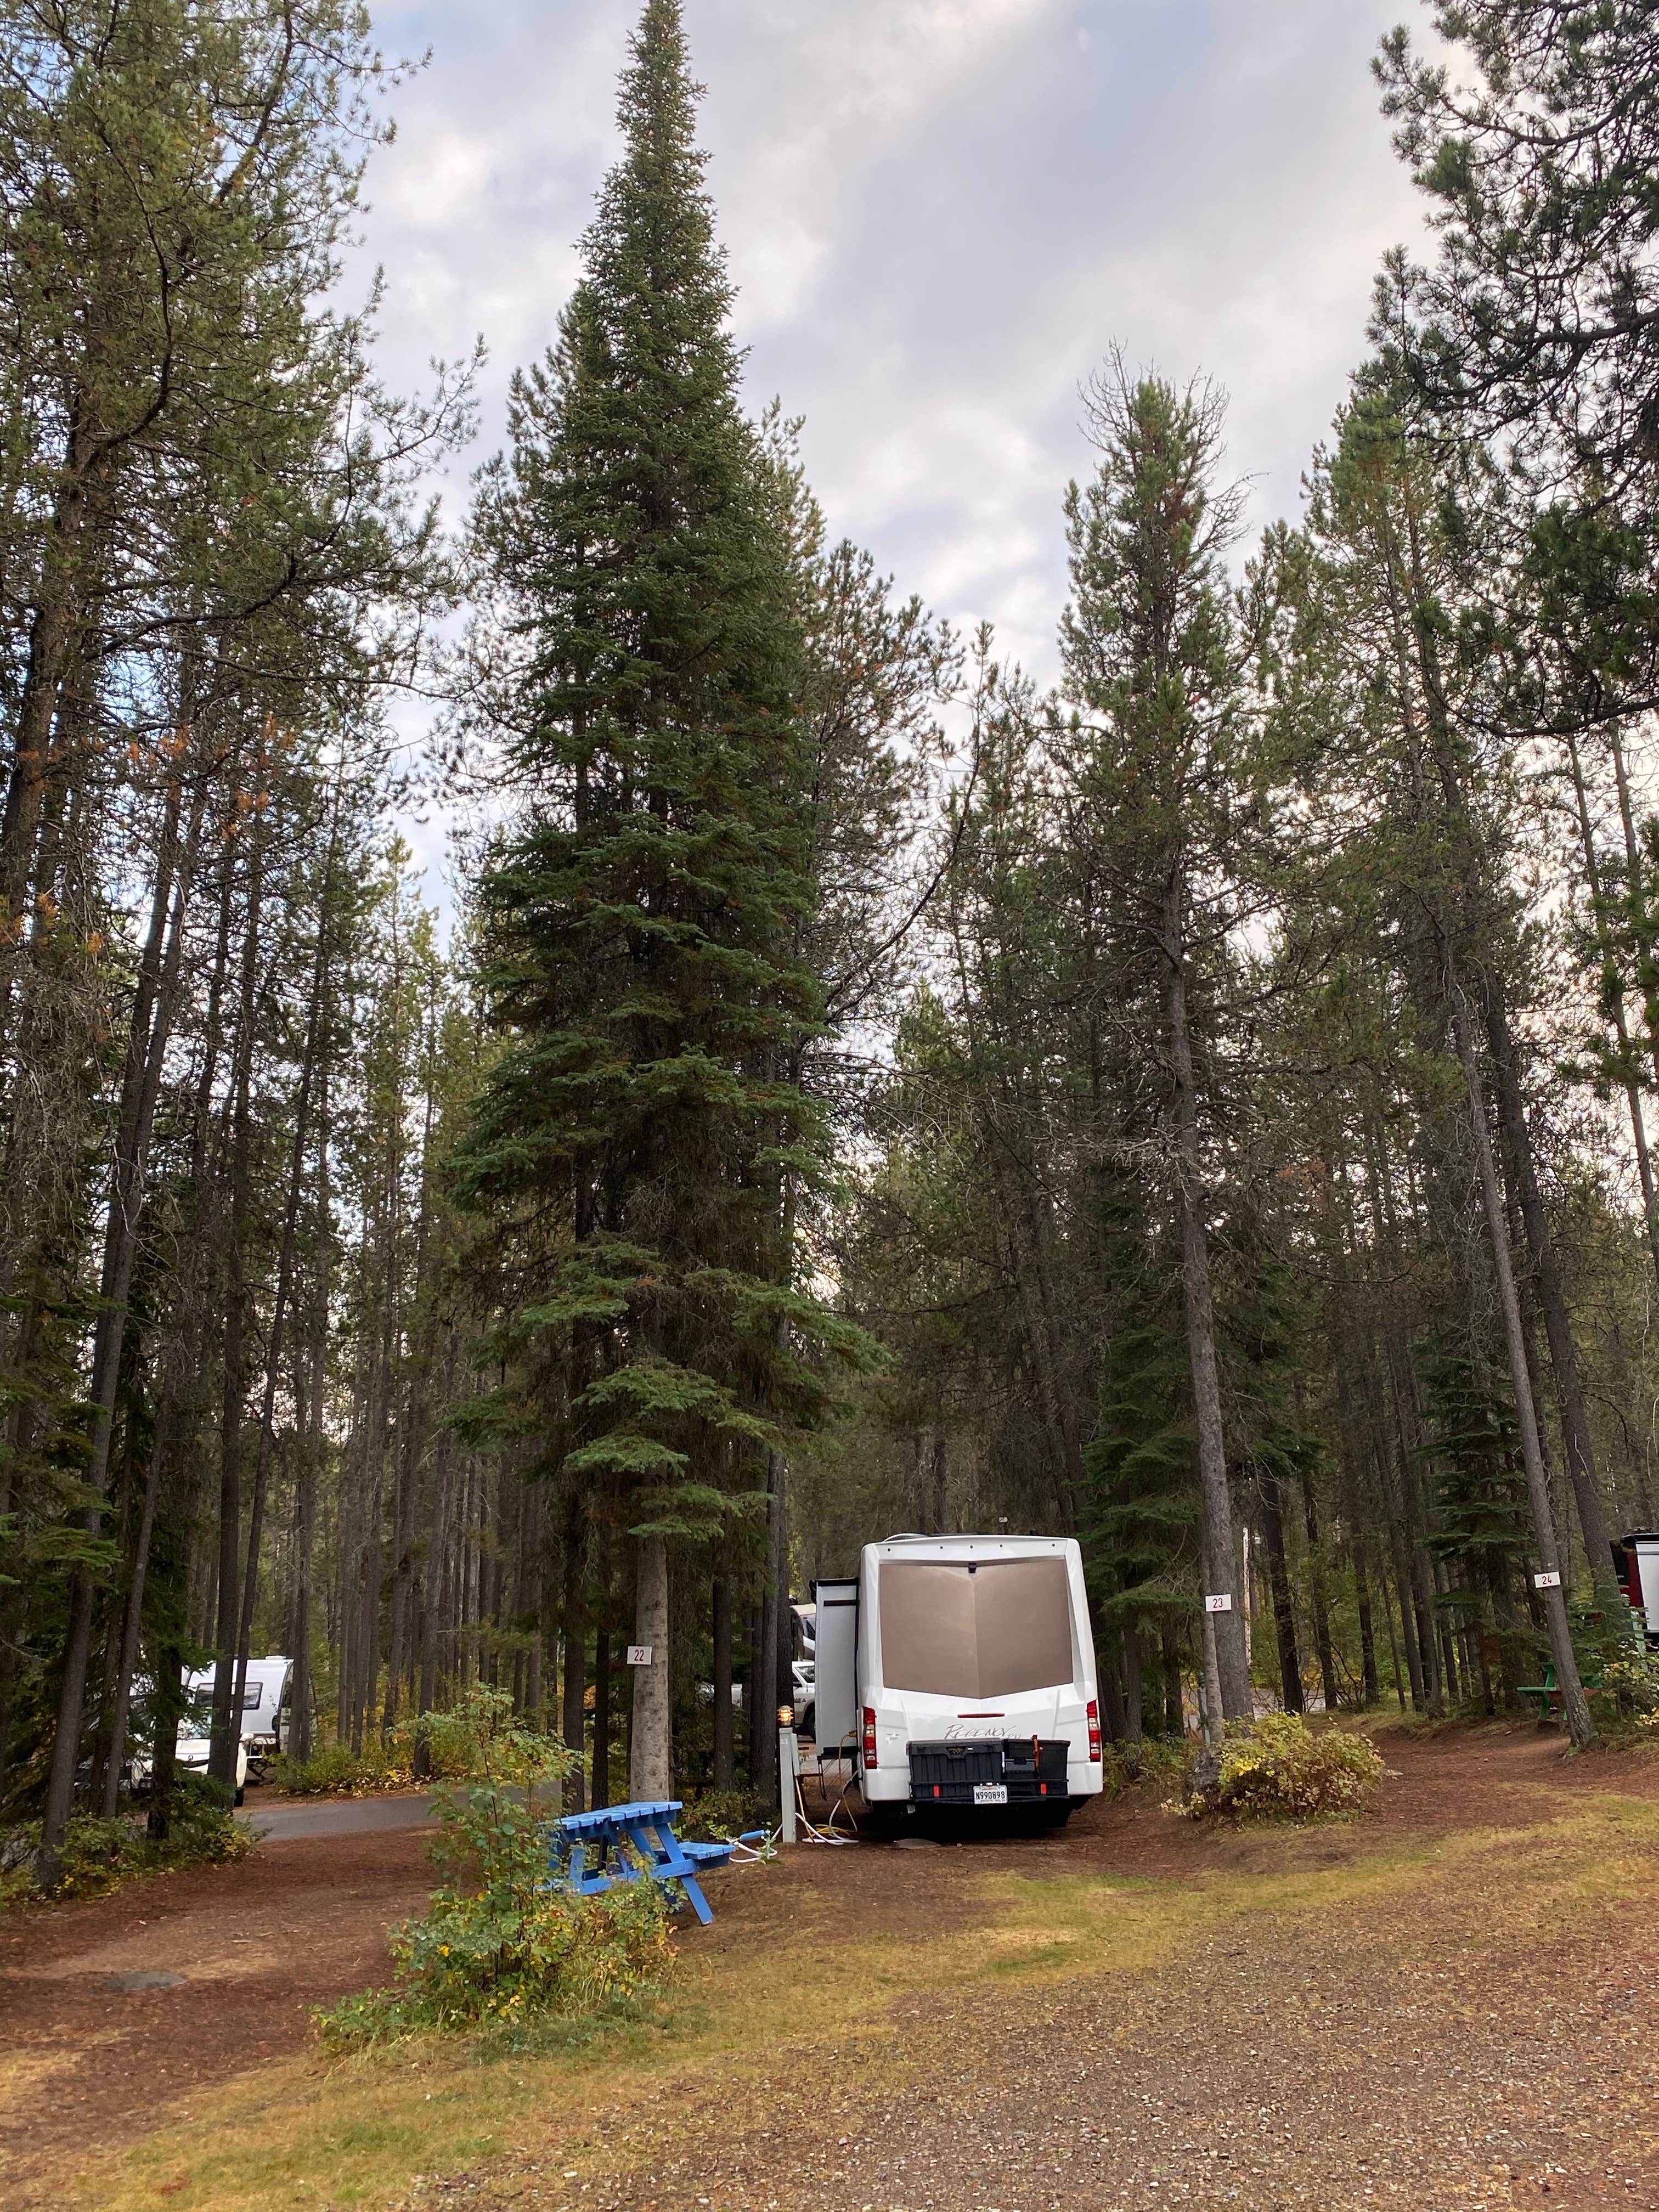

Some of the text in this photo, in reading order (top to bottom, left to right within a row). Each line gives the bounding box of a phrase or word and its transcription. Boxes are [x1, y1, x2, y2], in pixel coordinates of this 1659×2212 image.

[1542, 1575, 1552, 1584] 24
[1213, 1598, 1223, 1608] 23
[634, 1649, 644, 1661] 22
[976, 1791, 1005, 1799] N990898
